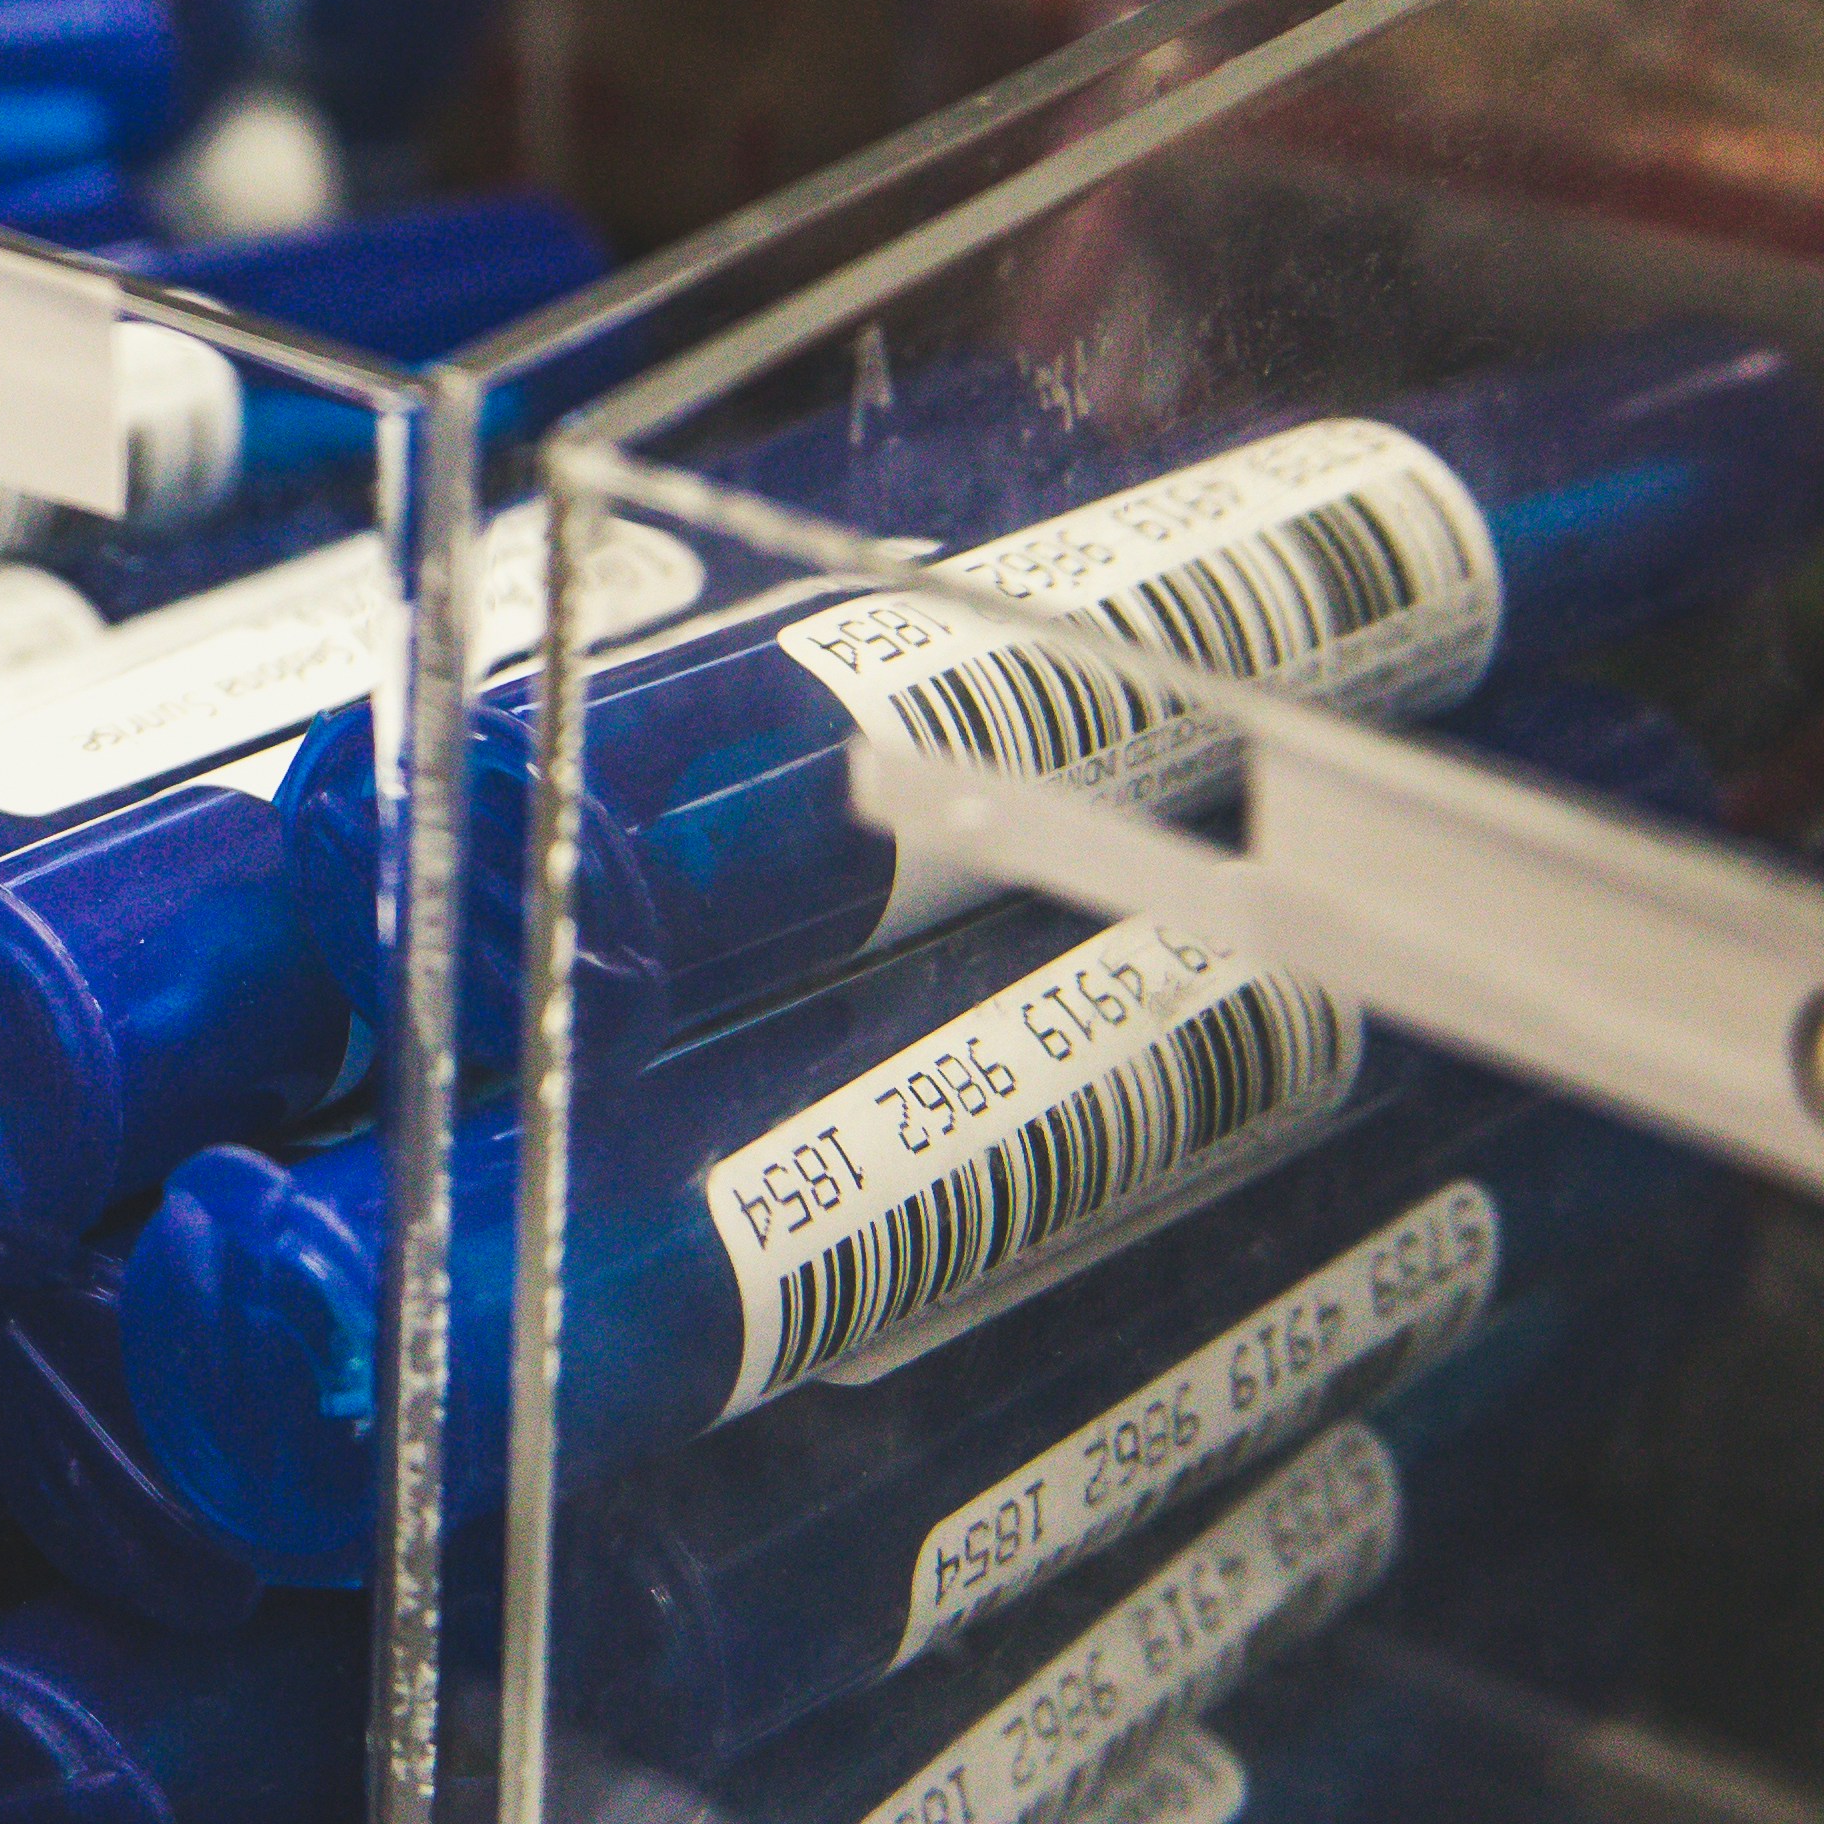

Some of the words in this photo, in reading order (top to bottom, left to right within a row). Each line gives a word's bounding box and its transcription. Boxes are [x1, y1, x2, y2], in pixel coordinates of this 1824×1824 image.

[807, 600, 953, 675] 1854
[1020, 956, 1146, 1062] 4919
[873, 1035, 1017, 1156] 9862
[731, 1124, 868, 1251] 1854
[1229, 1296, 1344, 1413] 4919
[1082, 1379, 1202, 1509] 9862
[933, 1479, 1046, 1607] 1854
[1002, 1649, 1119, 1789] 9862
